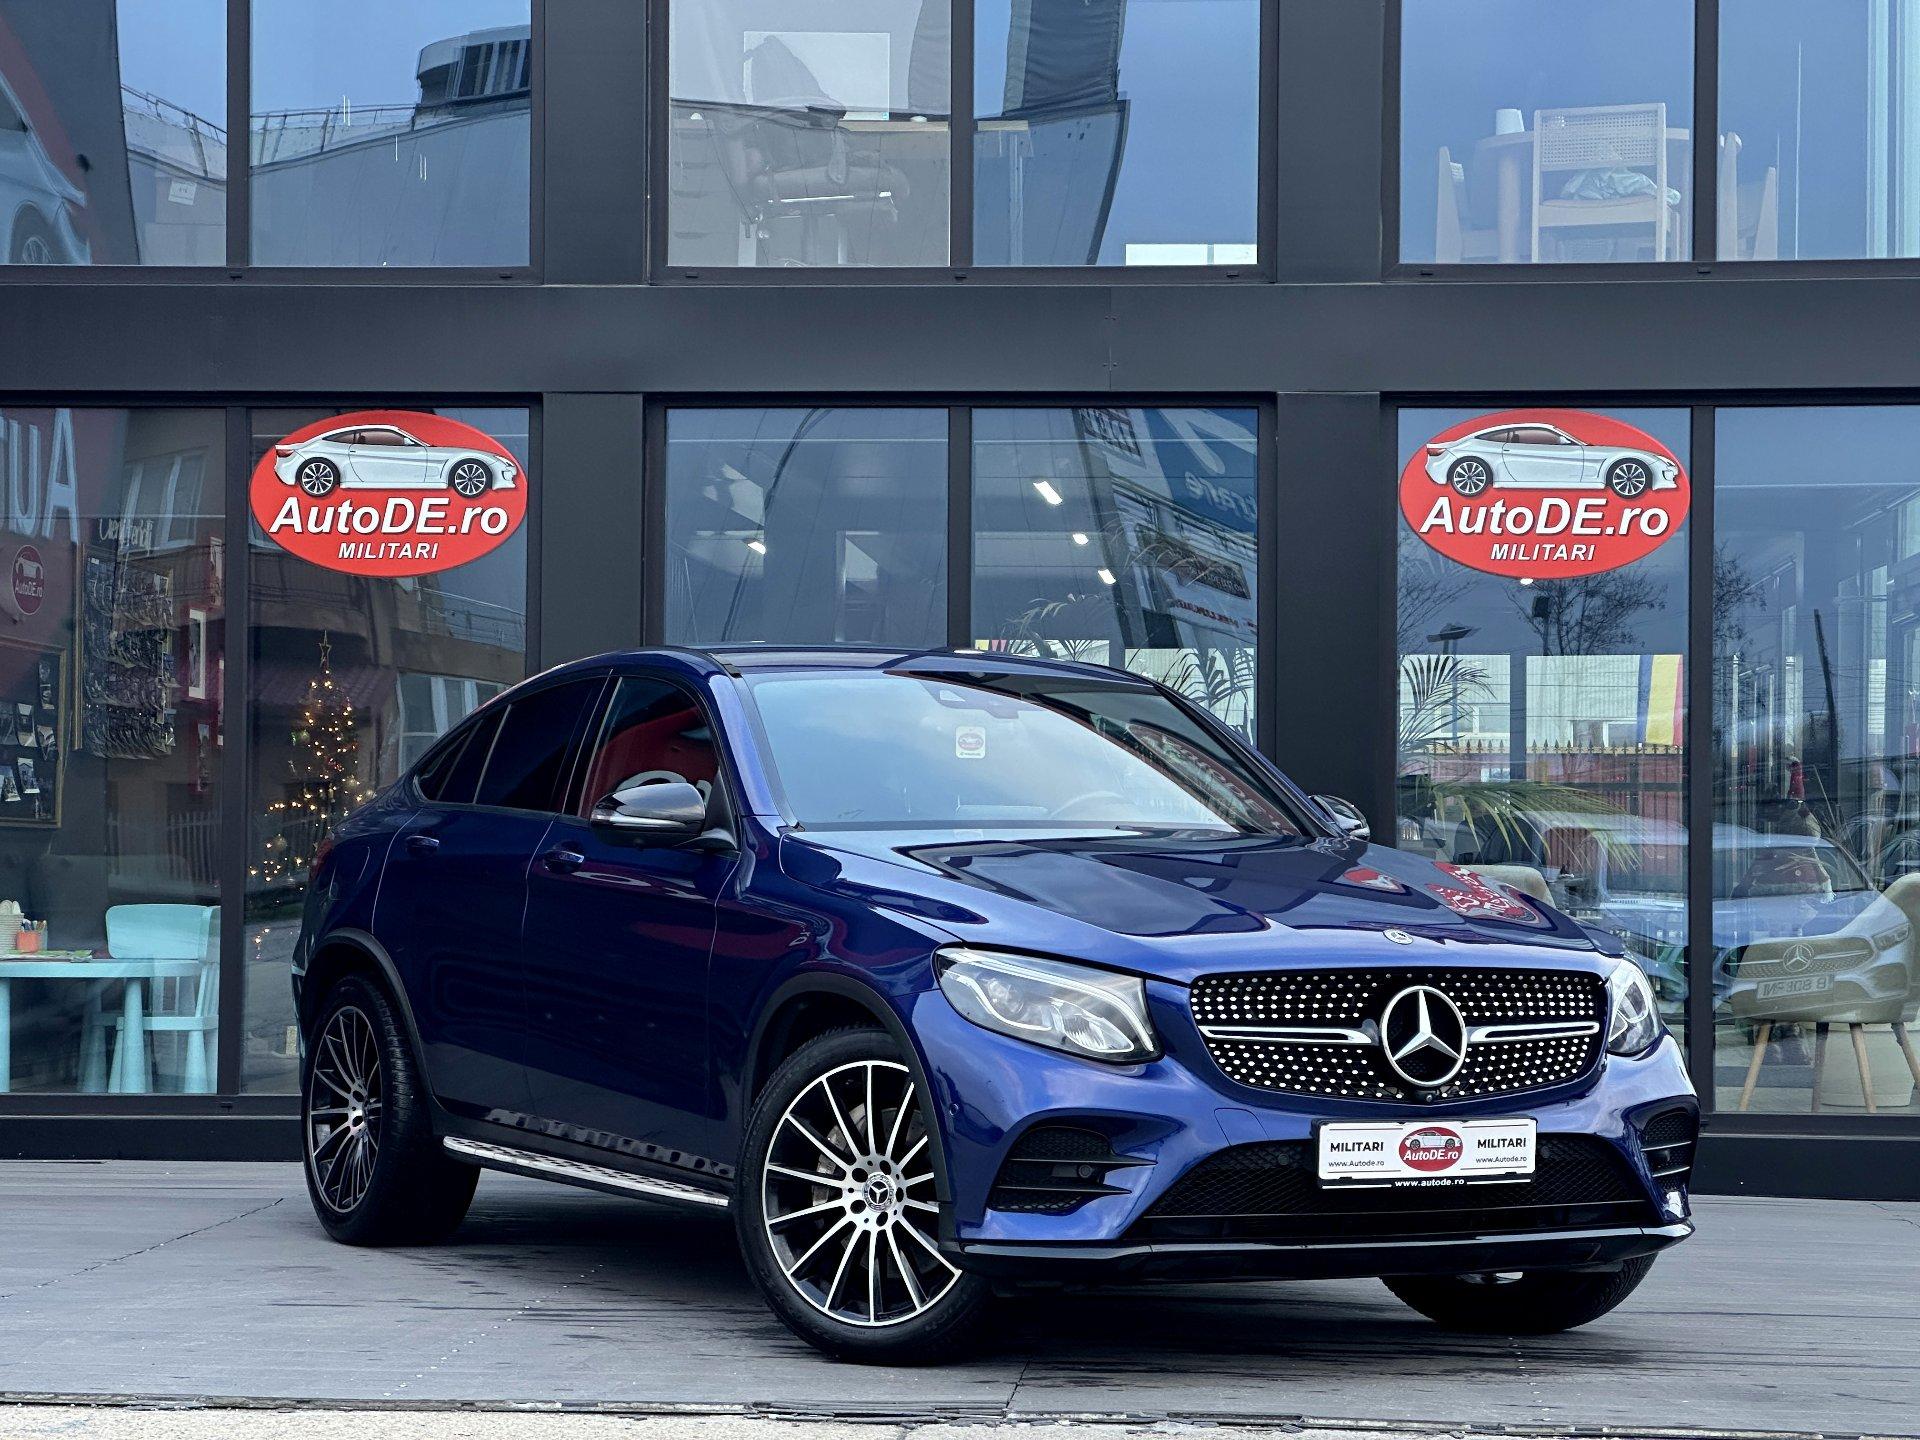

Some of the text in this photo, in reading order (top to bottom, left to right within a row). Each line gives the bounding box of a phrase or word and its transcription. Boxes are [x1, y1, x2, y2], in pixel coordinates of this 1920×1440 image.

[269, 496, 509, 535] AutoDE.ro
[1419, 496, 1670, 537] AutoDE.ro
[338, 542, 439, 560] MILITARI
[1490, 543, 1596, 562] MILITARI
[1330, 1141, 1385, 1153] MILITARI
[1476, 1137, 1527, 1150] MILITARI
[1403, 1148, 1459, 1161] AutoDE.ro
[1475, 1155, 1528, 1164] www.Autode.ro
[1328, 1158, 1385, 1168] www.Autode.ro
[1394, 1177, 1465, 1188] www.autode.ro
